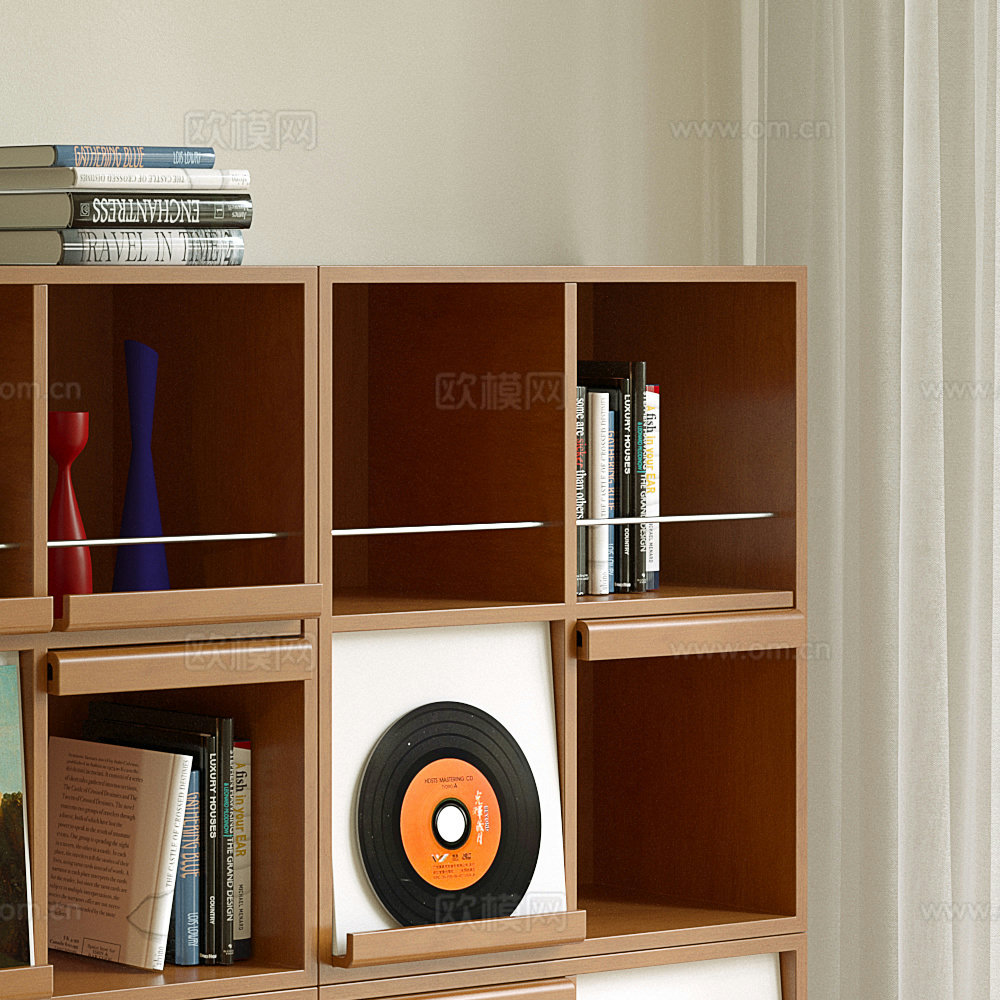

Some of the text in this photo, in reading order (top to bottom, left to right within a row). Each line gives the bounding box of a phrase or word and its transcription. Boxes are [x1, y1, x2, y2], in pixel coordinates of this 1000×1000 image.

[73, 146, 145, 168] GATHERING BLUE
[92, 198, 200, 223] ENCHANTRESS
[78, 231, 148, 262] TRAVEL
[155, 231, 173, 262] IN
[646, 413, 657, 433] fish
[646, 435, 656, 445] in
[646, 447, 654, 471] your
[646, 473, 656, 493] EAR
[235, 770, 248, 792] fish
[209, 753, 217, 838] LUXURY HOUSES
[236, 795, 247, 804] in
[233, 807, 245, 831] your
[180, 791, 200, 879] GATHERING BLUE
[236, 834, 247, 857] EAR
